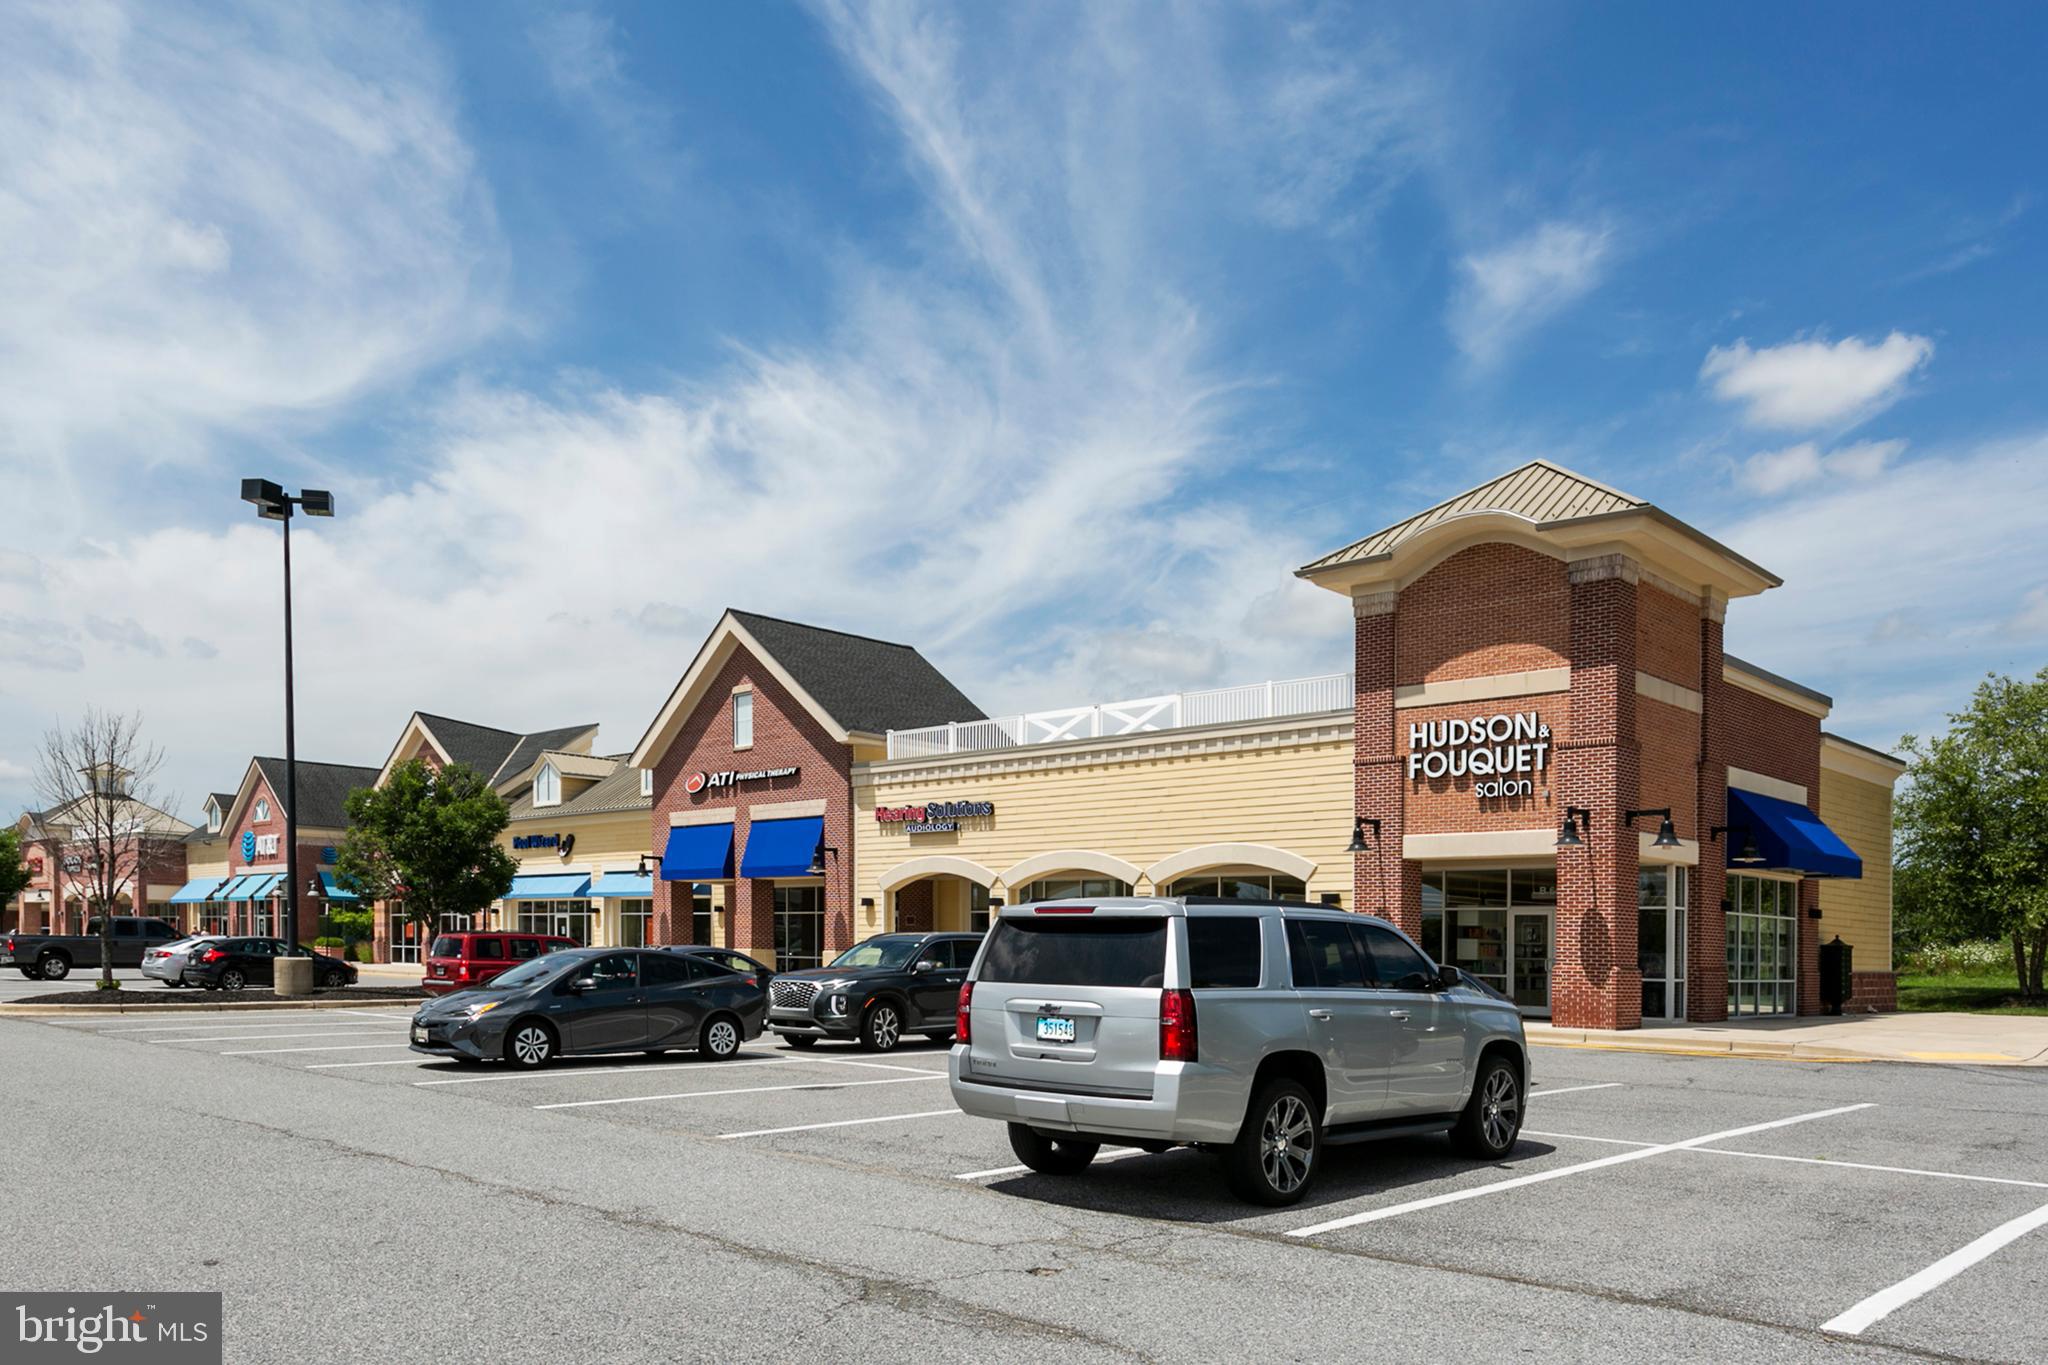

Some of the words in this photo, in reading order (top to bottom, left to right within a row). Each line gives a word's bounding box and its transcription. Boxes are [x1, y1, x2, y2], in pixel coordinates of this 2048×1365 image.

[1409, 711, 1537, 749] HUDSON
[1538, 724, 1550, 738] &
[1409, 743, 1548, 779] FOUQUET
[707, 771, 735, 787] ATI
[735, 769, 766, 780] PHYSICAL
[767, 767, 797, 778] THERAPY
[1475, 777, 1531, 798] salon
[875, 805, 926, 822] Hearing
[927, 801, 992, 818] Solutions
[906, 823, 953, 832] AUDIOLOGY
